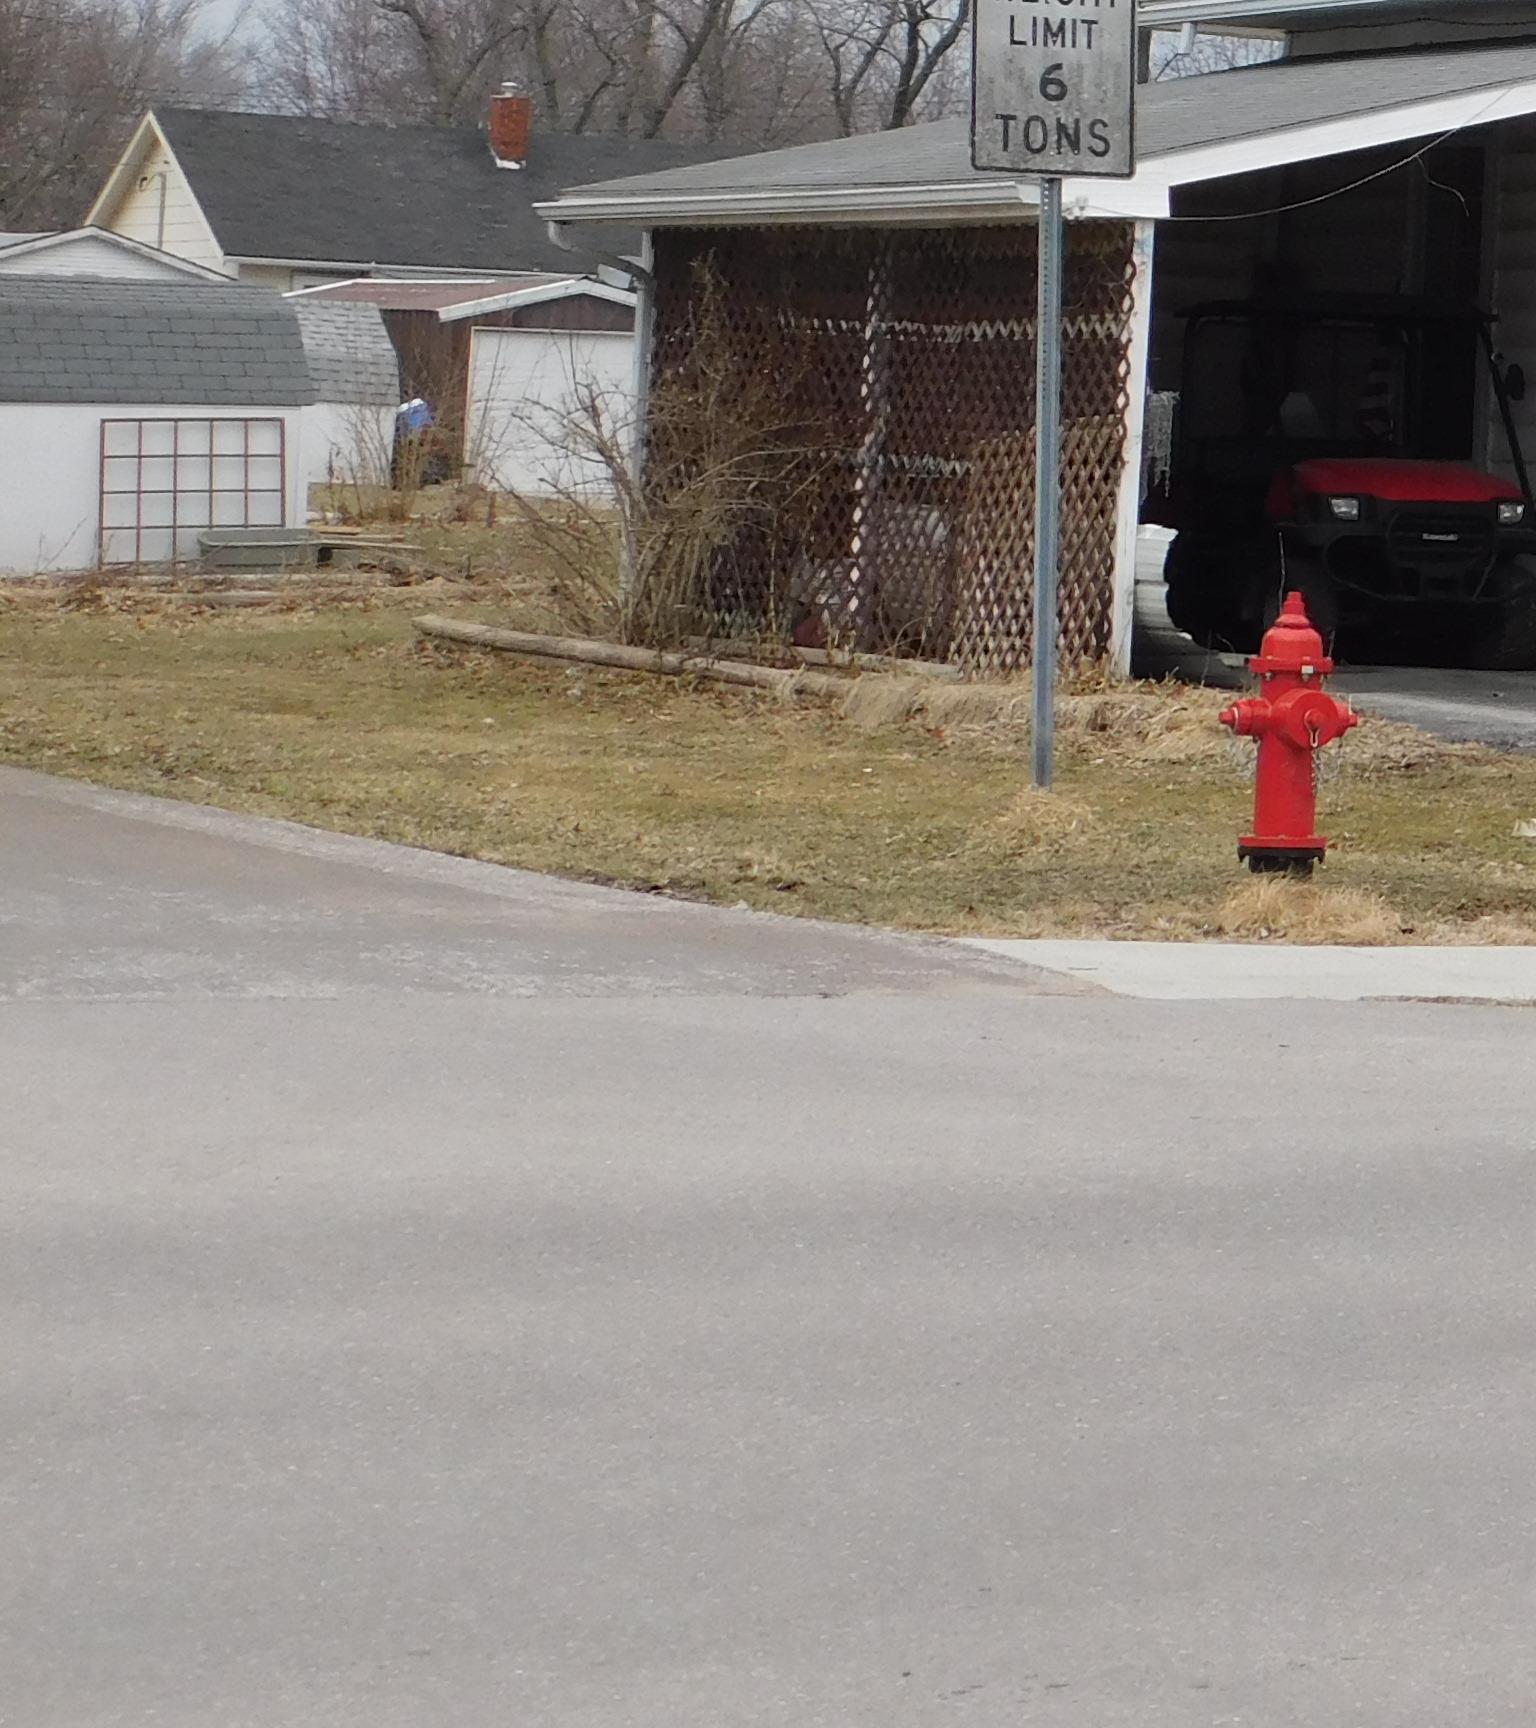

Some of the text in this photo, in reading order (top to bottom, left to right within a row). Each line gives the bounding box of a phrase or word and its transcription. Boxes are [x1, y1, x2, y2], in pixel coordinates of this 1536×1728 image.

[1009, 15, 1098, 49] LIMIT
[1039, 63, 1068, 101] 6
[994, 114, 1110, 157] TONS
